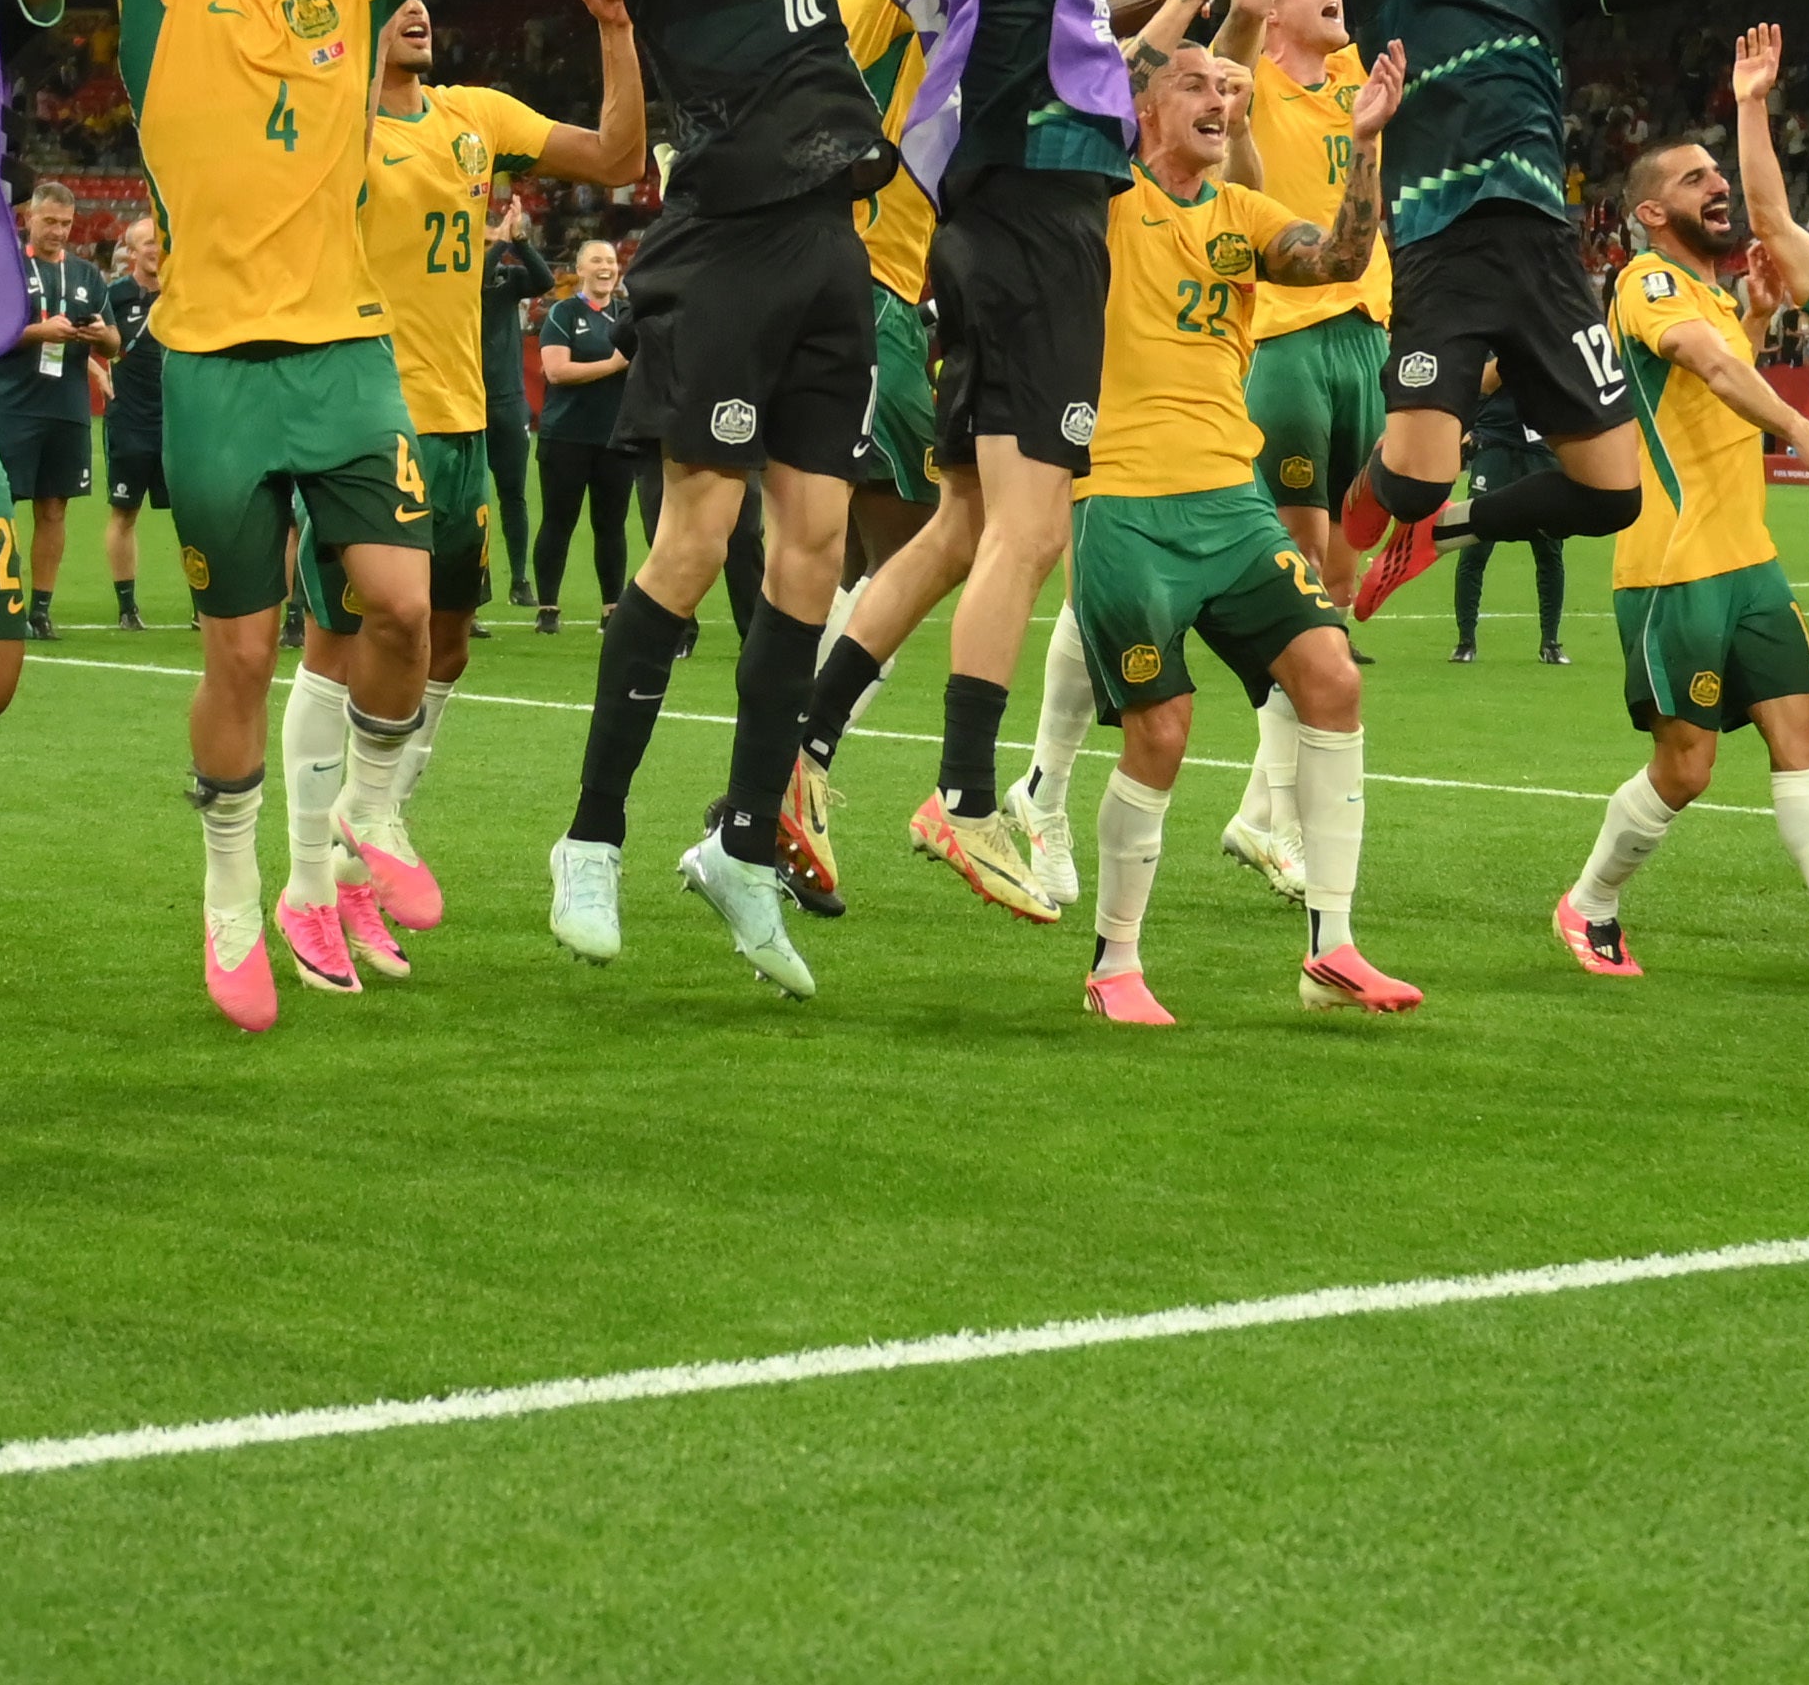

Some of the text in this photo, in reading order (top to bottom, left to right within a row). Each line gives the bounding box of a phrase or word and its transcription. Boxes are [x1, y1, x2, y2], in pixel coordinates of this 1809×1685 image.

[265, 79, 299, 153] 4
[424, 211, 473, 274] 23
[1177, 279, 1229, 336] 22
[1571, 323, 1625, 388] 12
[396, 433, 425, 504] 4
